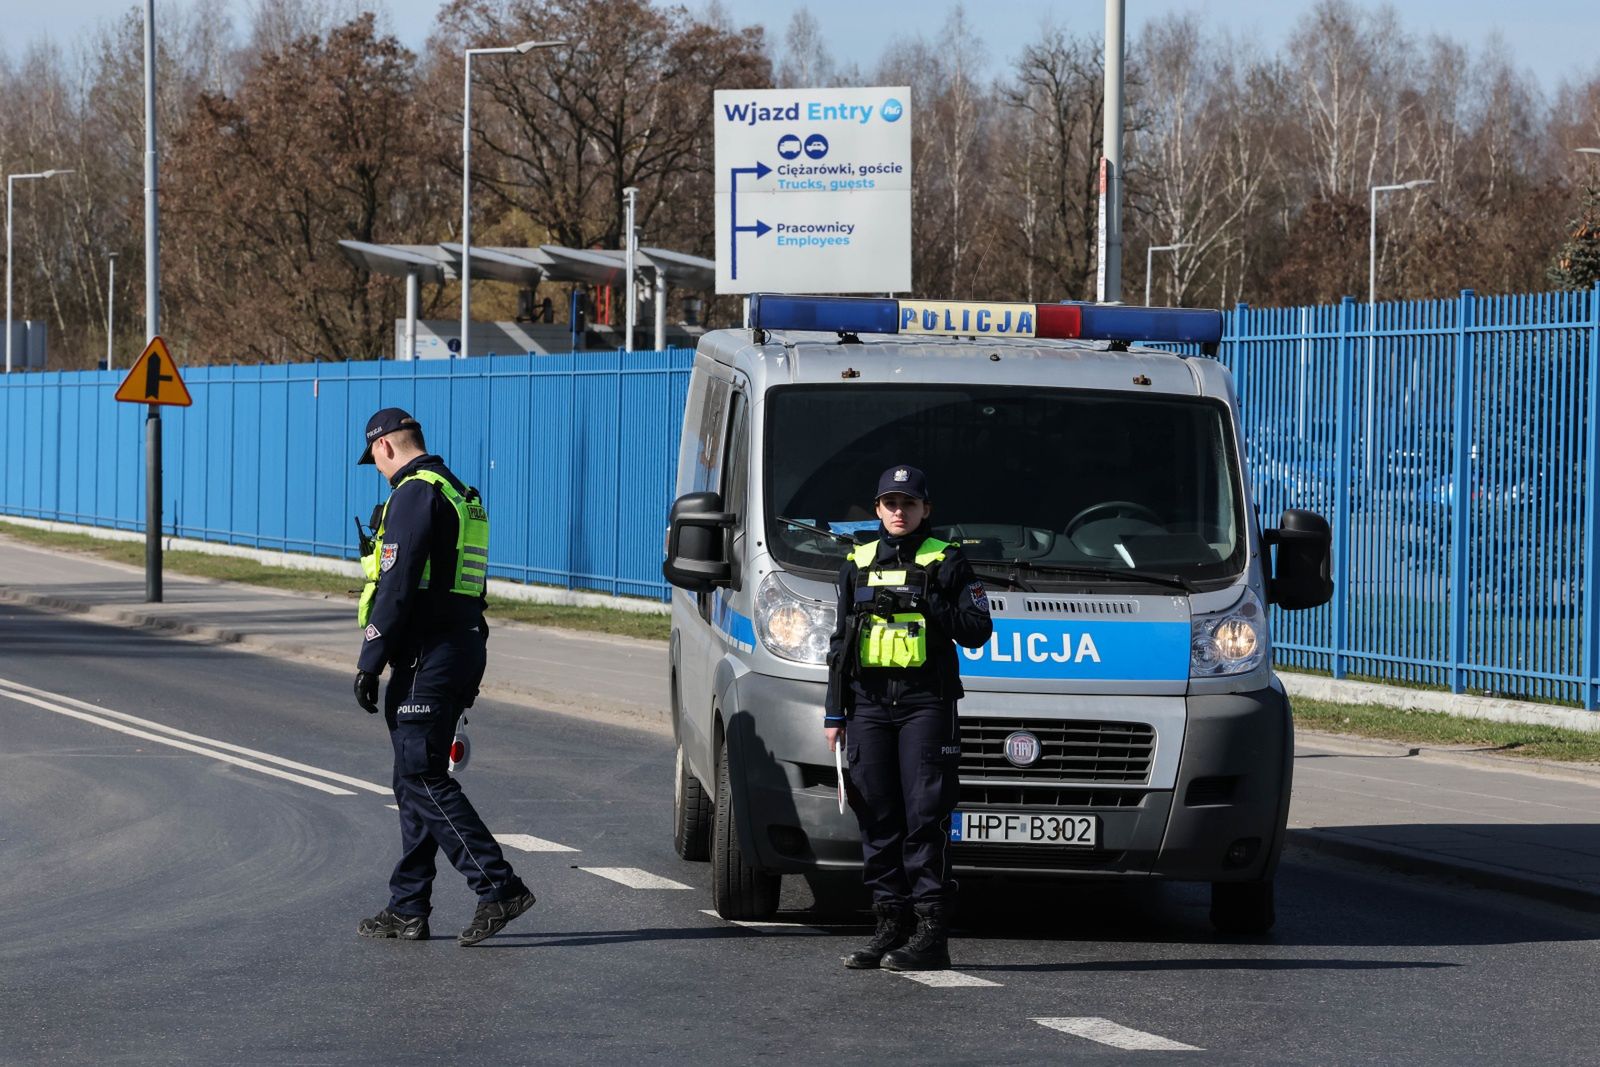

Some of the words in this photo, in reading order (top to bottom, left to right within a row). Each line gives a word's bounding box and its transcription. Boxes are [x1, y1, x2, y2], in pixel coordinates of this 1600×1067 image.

[724, 102, 800, 126] Wjazd
[807, 103, 873, 124] Entry
[777, 163, 855, 177] Ciężarówki,
[859, 162, 903, 176] goście
[778, 179, 826, 190] Trucks,
[830, 179, 875, 191] guests
[777, 221, 855, 235] Pracownicy
[777, 235, 850, 247] Employees
[901, 307, 1033, 333] POLICJA
[952, 632, 1101, 663] LICJA
[397, 704, 431, 714] POLICJA
[1012, 741, 1033, 757] FIAT
[967, 815, 1020, 840] HPF
[1030, 816, 1091, 842] B302
